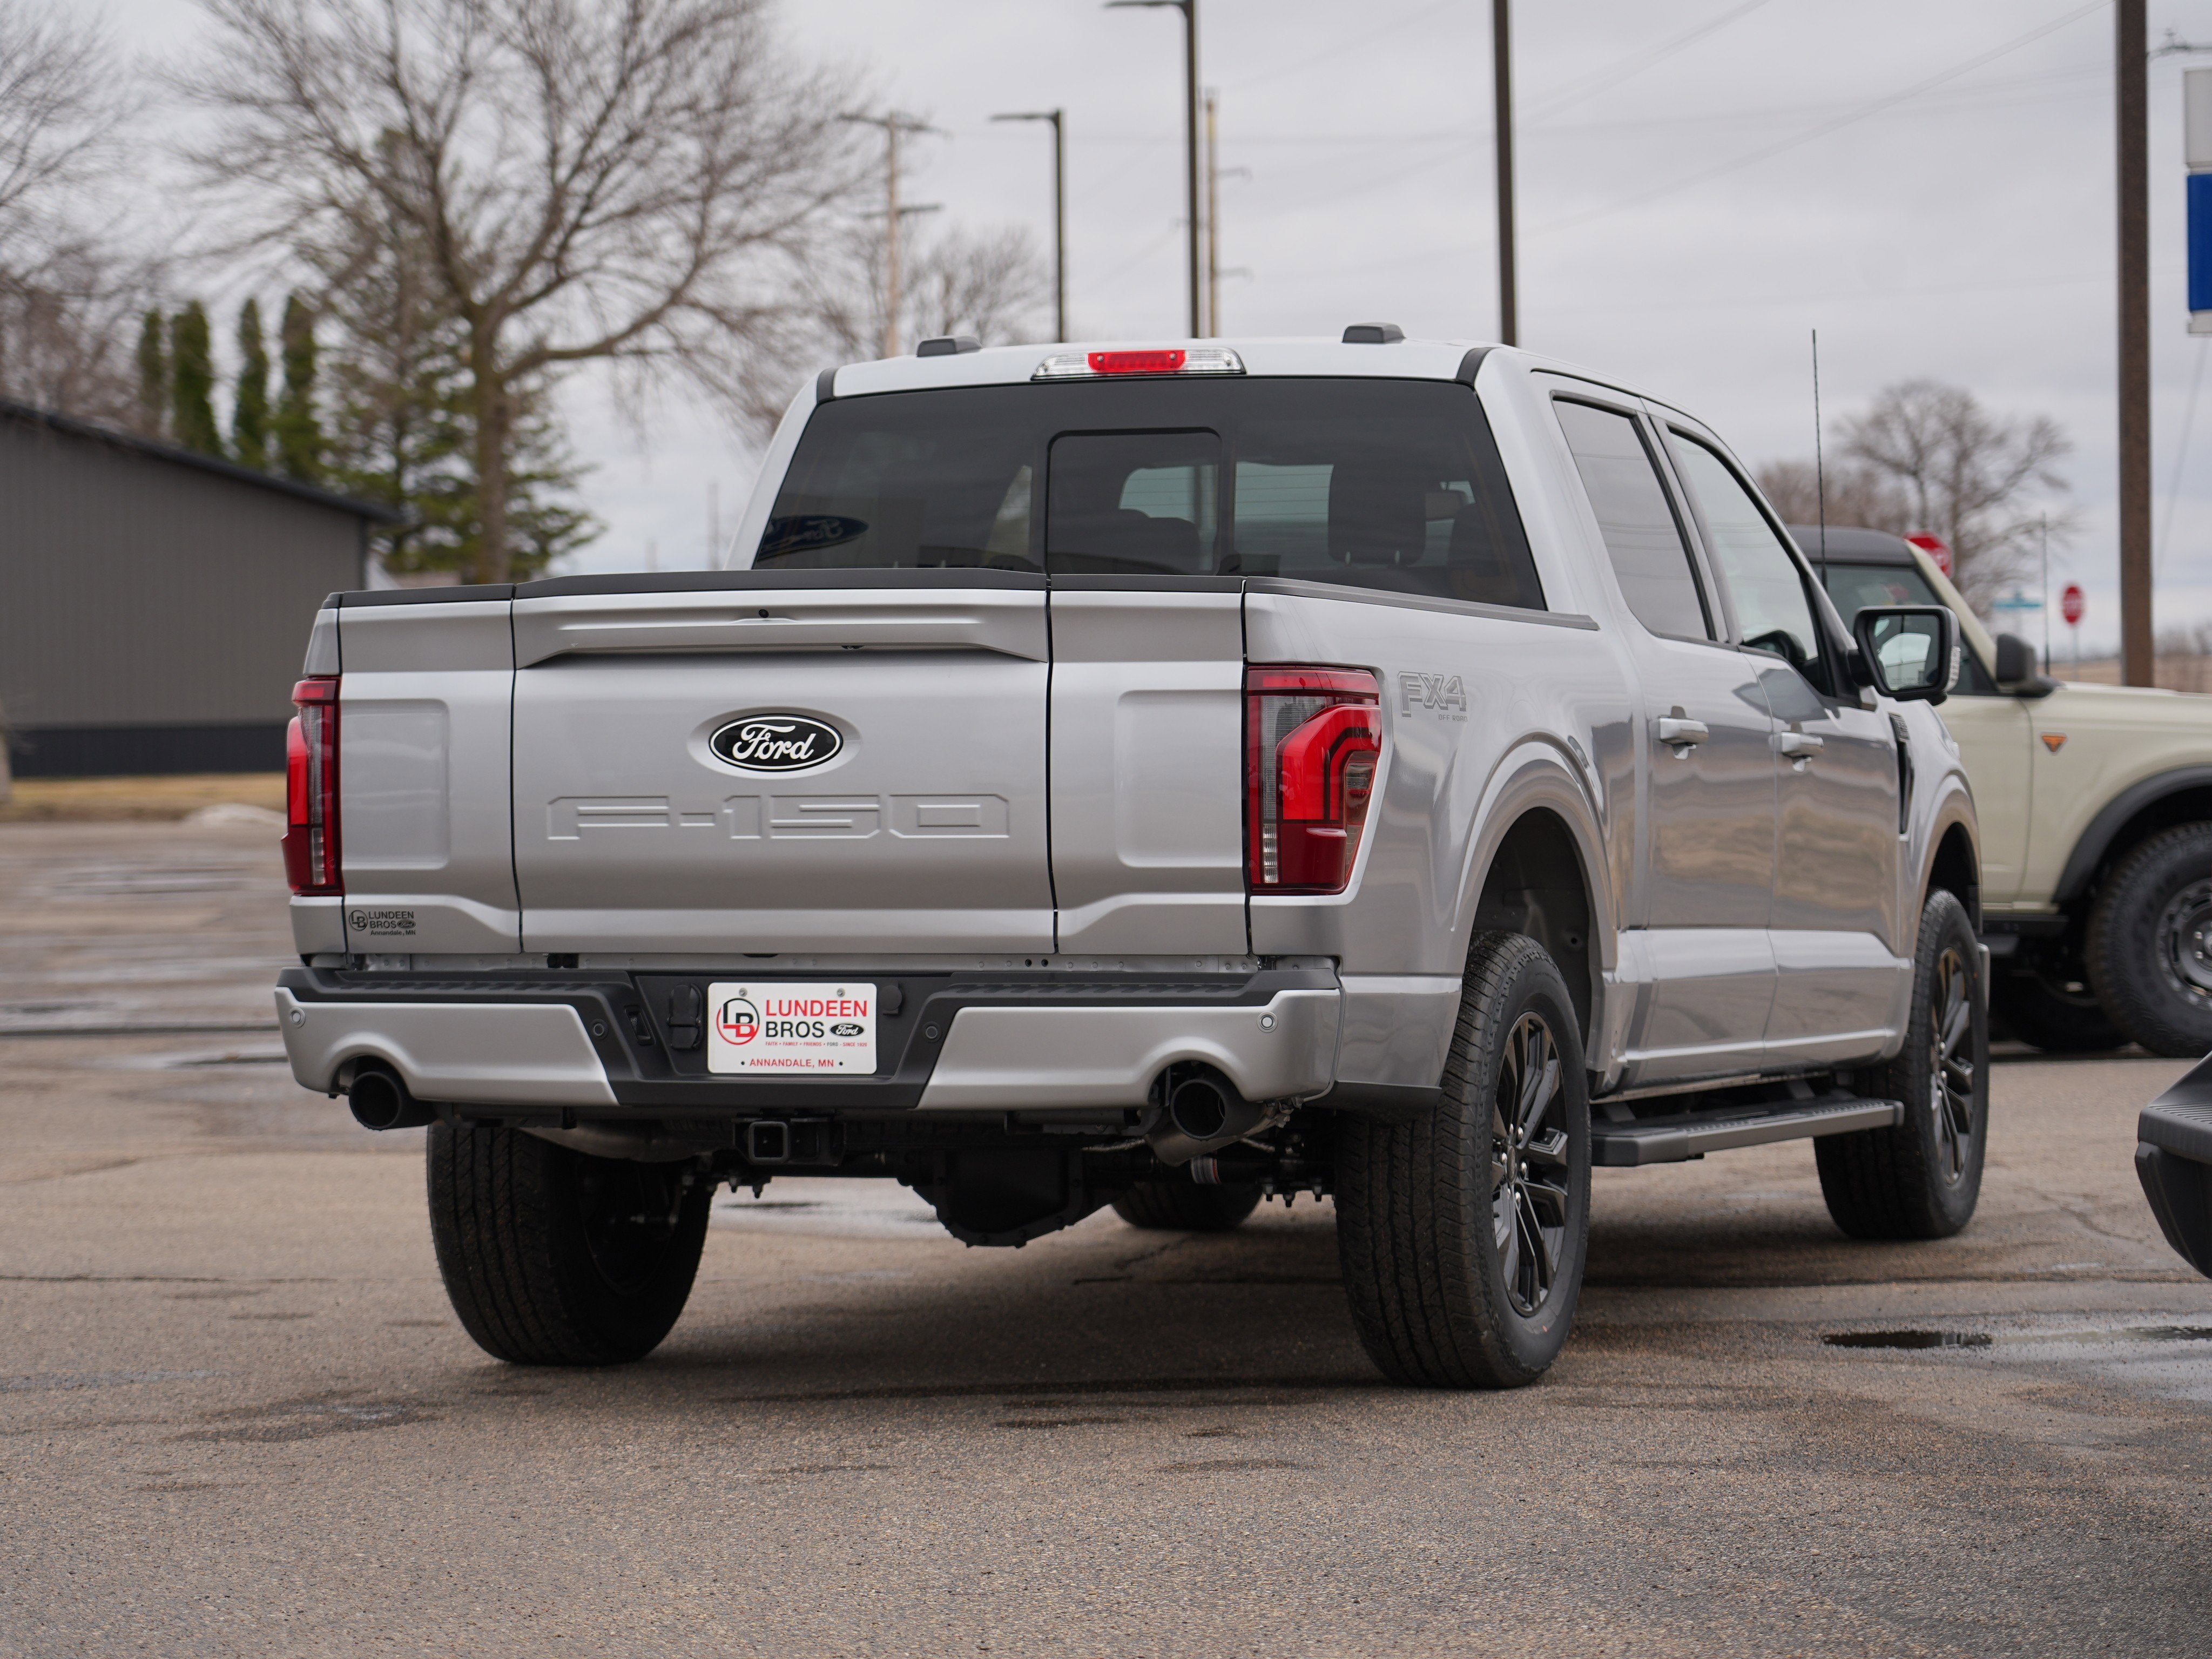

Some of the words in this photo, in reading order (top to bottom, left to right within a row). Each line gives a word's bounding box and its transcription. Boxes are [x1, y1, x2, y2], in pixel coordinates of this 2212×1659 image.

[1397, 671, 1466, 717] FX4
[732, 724, 817, 760] Ford
[547, 794, 1010, 840] F-150
[370, 920, 397, 928] BROS
[766, 1000, 867, 1017] LUNDEEN
[766, 1021, 825, 1038] BROS
[835, 1024, 859, 1036] Ford
[750, 1059, 815, 1068] ANNANDALE,
[818, 1059, 834, 1067] MN
